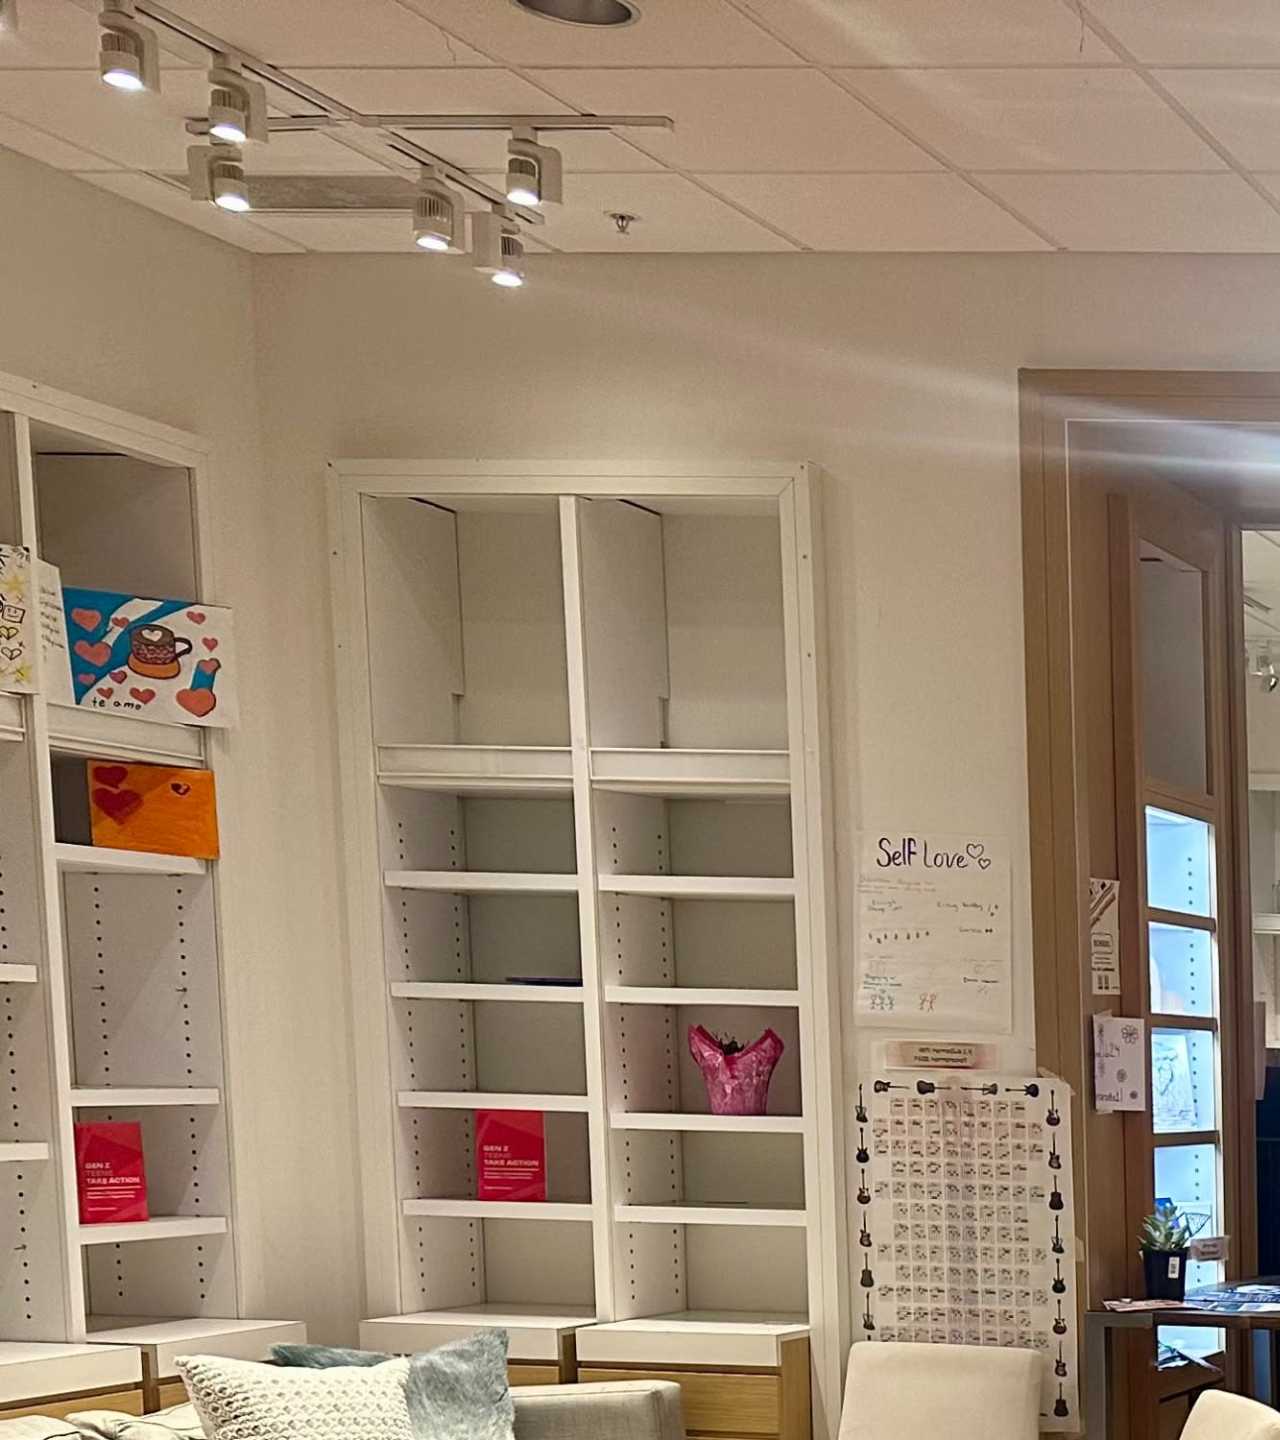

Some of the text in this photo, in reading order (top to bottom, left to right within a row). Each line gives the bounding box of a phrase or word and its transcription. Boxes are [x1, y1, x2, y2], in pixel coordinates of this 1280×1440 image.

[92, 698, 142, 710] te amo
[109, 1176, 140, 1184] ACTION
